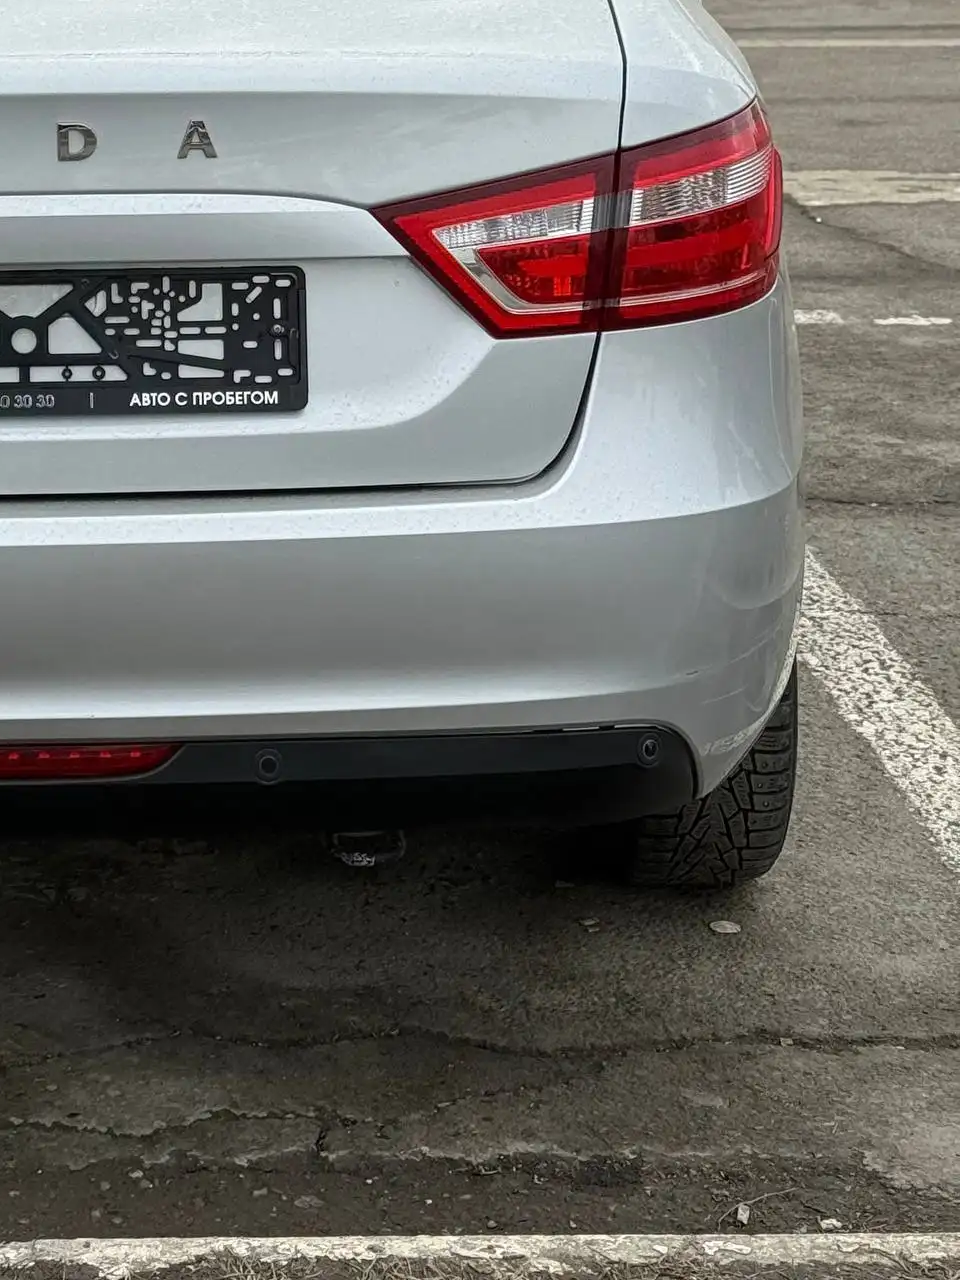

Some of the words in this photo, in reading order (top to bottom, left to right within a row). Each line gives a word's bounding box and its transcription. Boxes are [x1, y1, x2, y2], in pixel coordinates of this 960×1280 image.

[14, 394, 33, 409] 30
[36, 394, 55, 408] 30
[129, 392, 171, 407] АВТО
[174, 392, 189, 406] С
[192, 390, 279, 406] ПРОБЕГОМ
